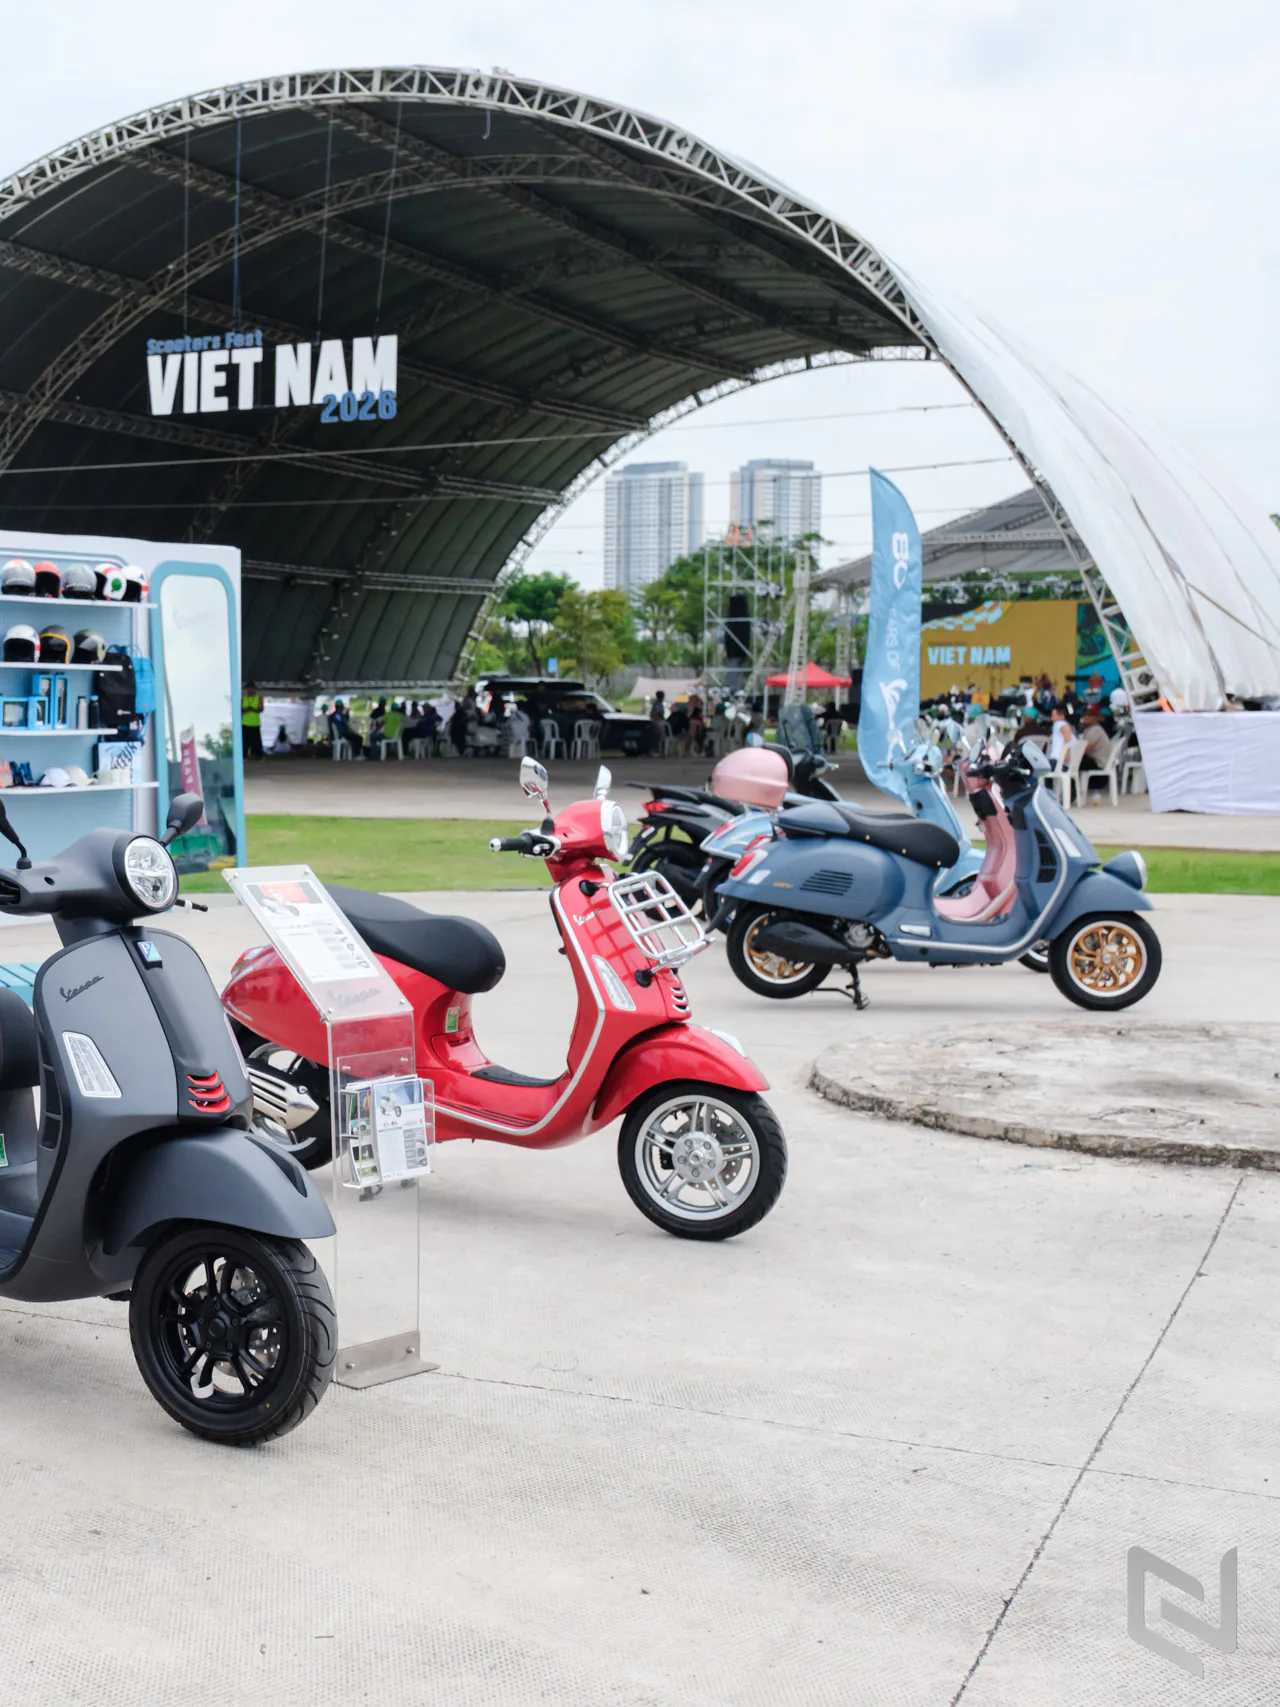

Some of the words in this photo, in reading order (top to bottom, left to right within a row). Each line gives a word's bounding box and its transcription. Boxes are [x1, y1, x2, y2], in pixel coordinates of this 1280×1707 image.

[147, 333, 221, 355] Scooters
[225, 330, 263, 350] Fest
[147, 347, 263, 416] VIET
[274, 334, 398, 408] NAM
[321, 390, 398, 423] 2026
[927, 646, 967, 666] VIET
[970, 646, 1011, 666] NAM
[59, 975, 104, 1002] Vespa
